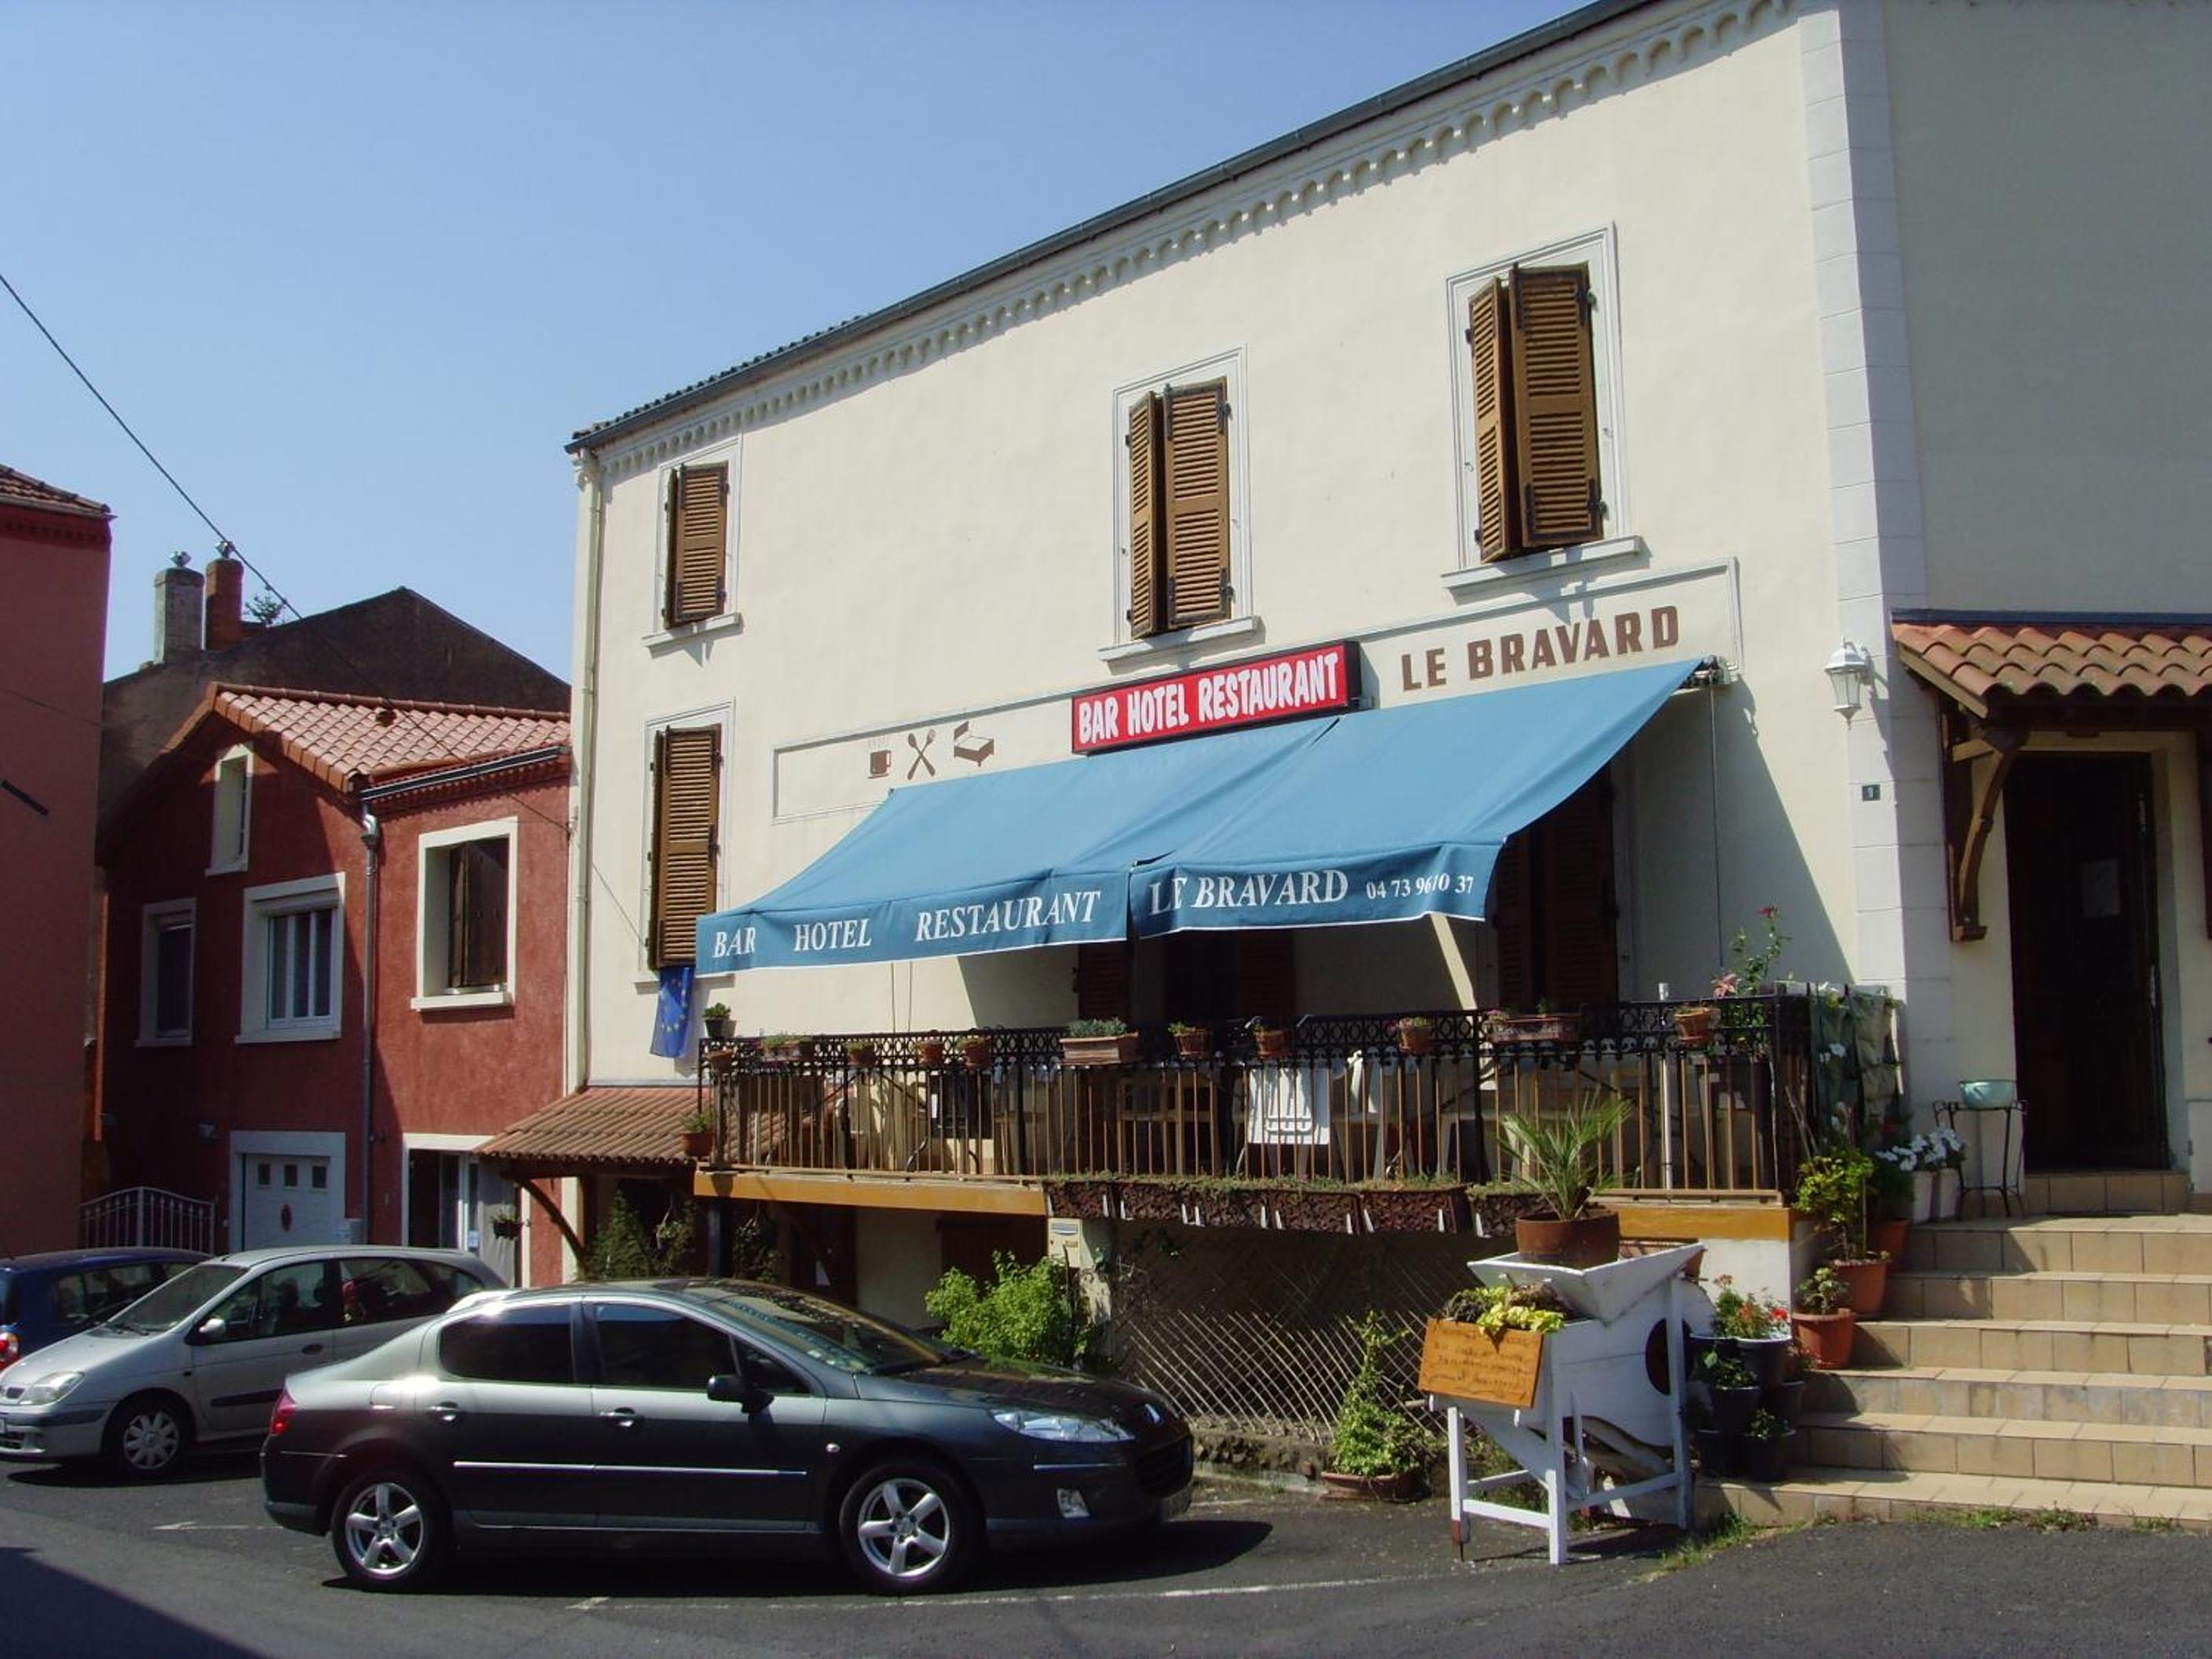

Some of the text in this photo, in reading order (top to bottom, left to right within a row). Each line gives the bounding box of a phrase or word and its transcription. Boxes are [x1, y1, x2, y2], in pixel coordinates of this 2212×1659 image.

[1401, 606, 1679, 691] LE BRAVARD
[1079, 653, 1339, 744] BAR HOTEL RESTAURANT
[712, 890, 1102, 958] BAR HOTEL RESTAURANT
[1148, 877, 1188, 916] LE
[1190, 869, 1349, 908] BRAVARD
[1366, 880, 1387, 899] 04
[1390, 877, 1412, 898] 73
[1455, 874, 1474, 894] 37
